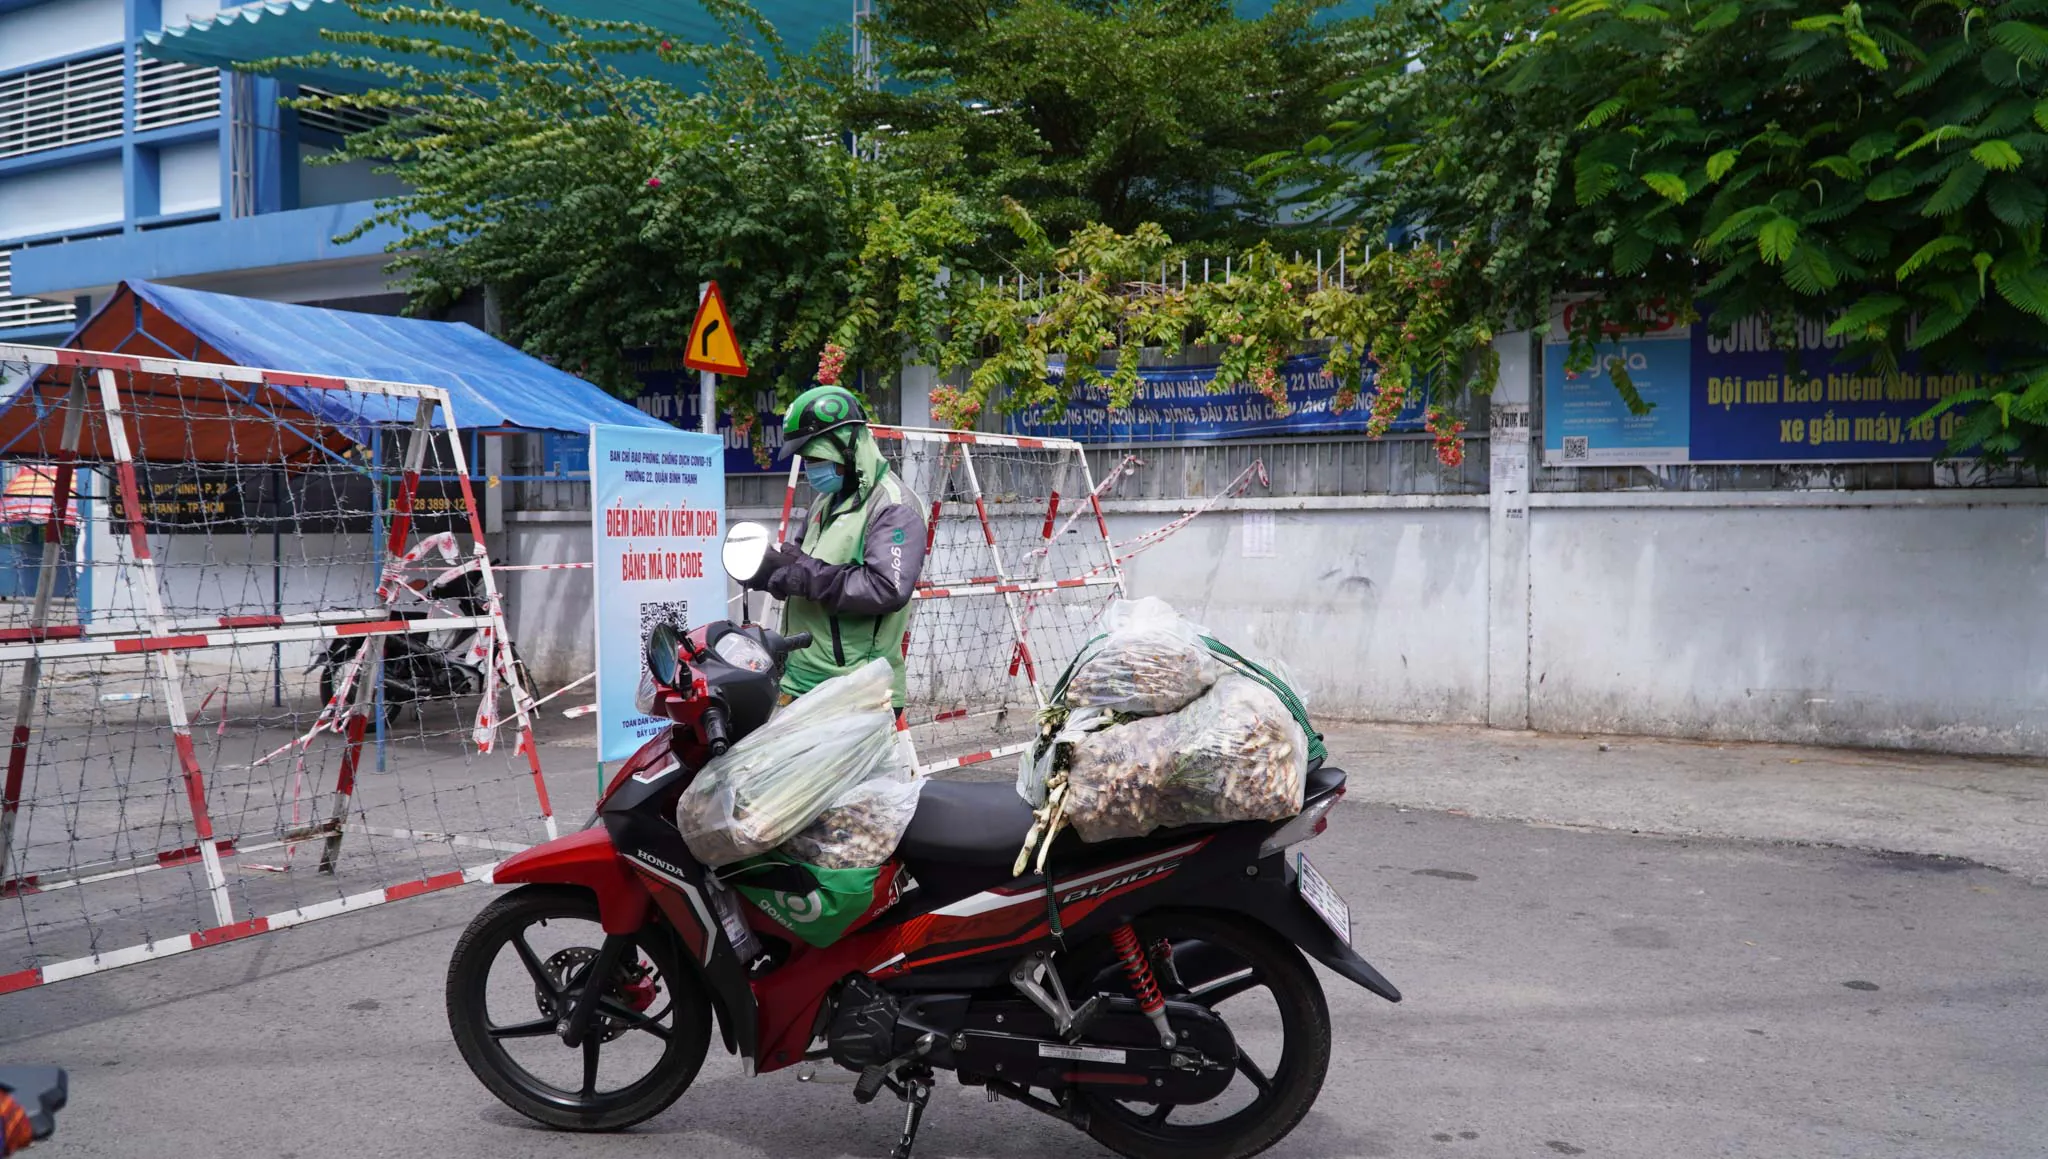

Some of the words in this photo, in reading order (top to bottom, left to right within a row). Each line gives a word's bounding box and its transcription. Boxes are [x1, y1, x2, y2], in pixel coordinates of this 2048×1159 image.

[1153, 381, 1175, 399] BAN
[1291, 375, 1306, 392] 22
[1707, 375, 1742, 411] Đội
[1745, 372, 1778, 404] mũ
[1886, 371, 1921, 401] hi
[1225, 403, 1239, 421] XE
[1780, 417, 1805, 443] xe
[610, 450, 621, 462] BAN
[691, 455, 712, 467] COVID-19
[606, 497, 630, 537] ĐIỂM
[632, 503, 656, 537] ĐĂNG
[658, 504, 670, 536] KÝ
[672, 499, 694, 536] KIỂM
[696, 510, 717, 542] DỊCH
[622, 542, 646, 581] BẰNG
[648, 547, 663, 580] MÃ
[665, 552, 677, 582] QR
[680, 551, 703, 578] CODE
[637, 848, 686, 878] HONDA
[1062, 856, 1184, 904] BLADE
